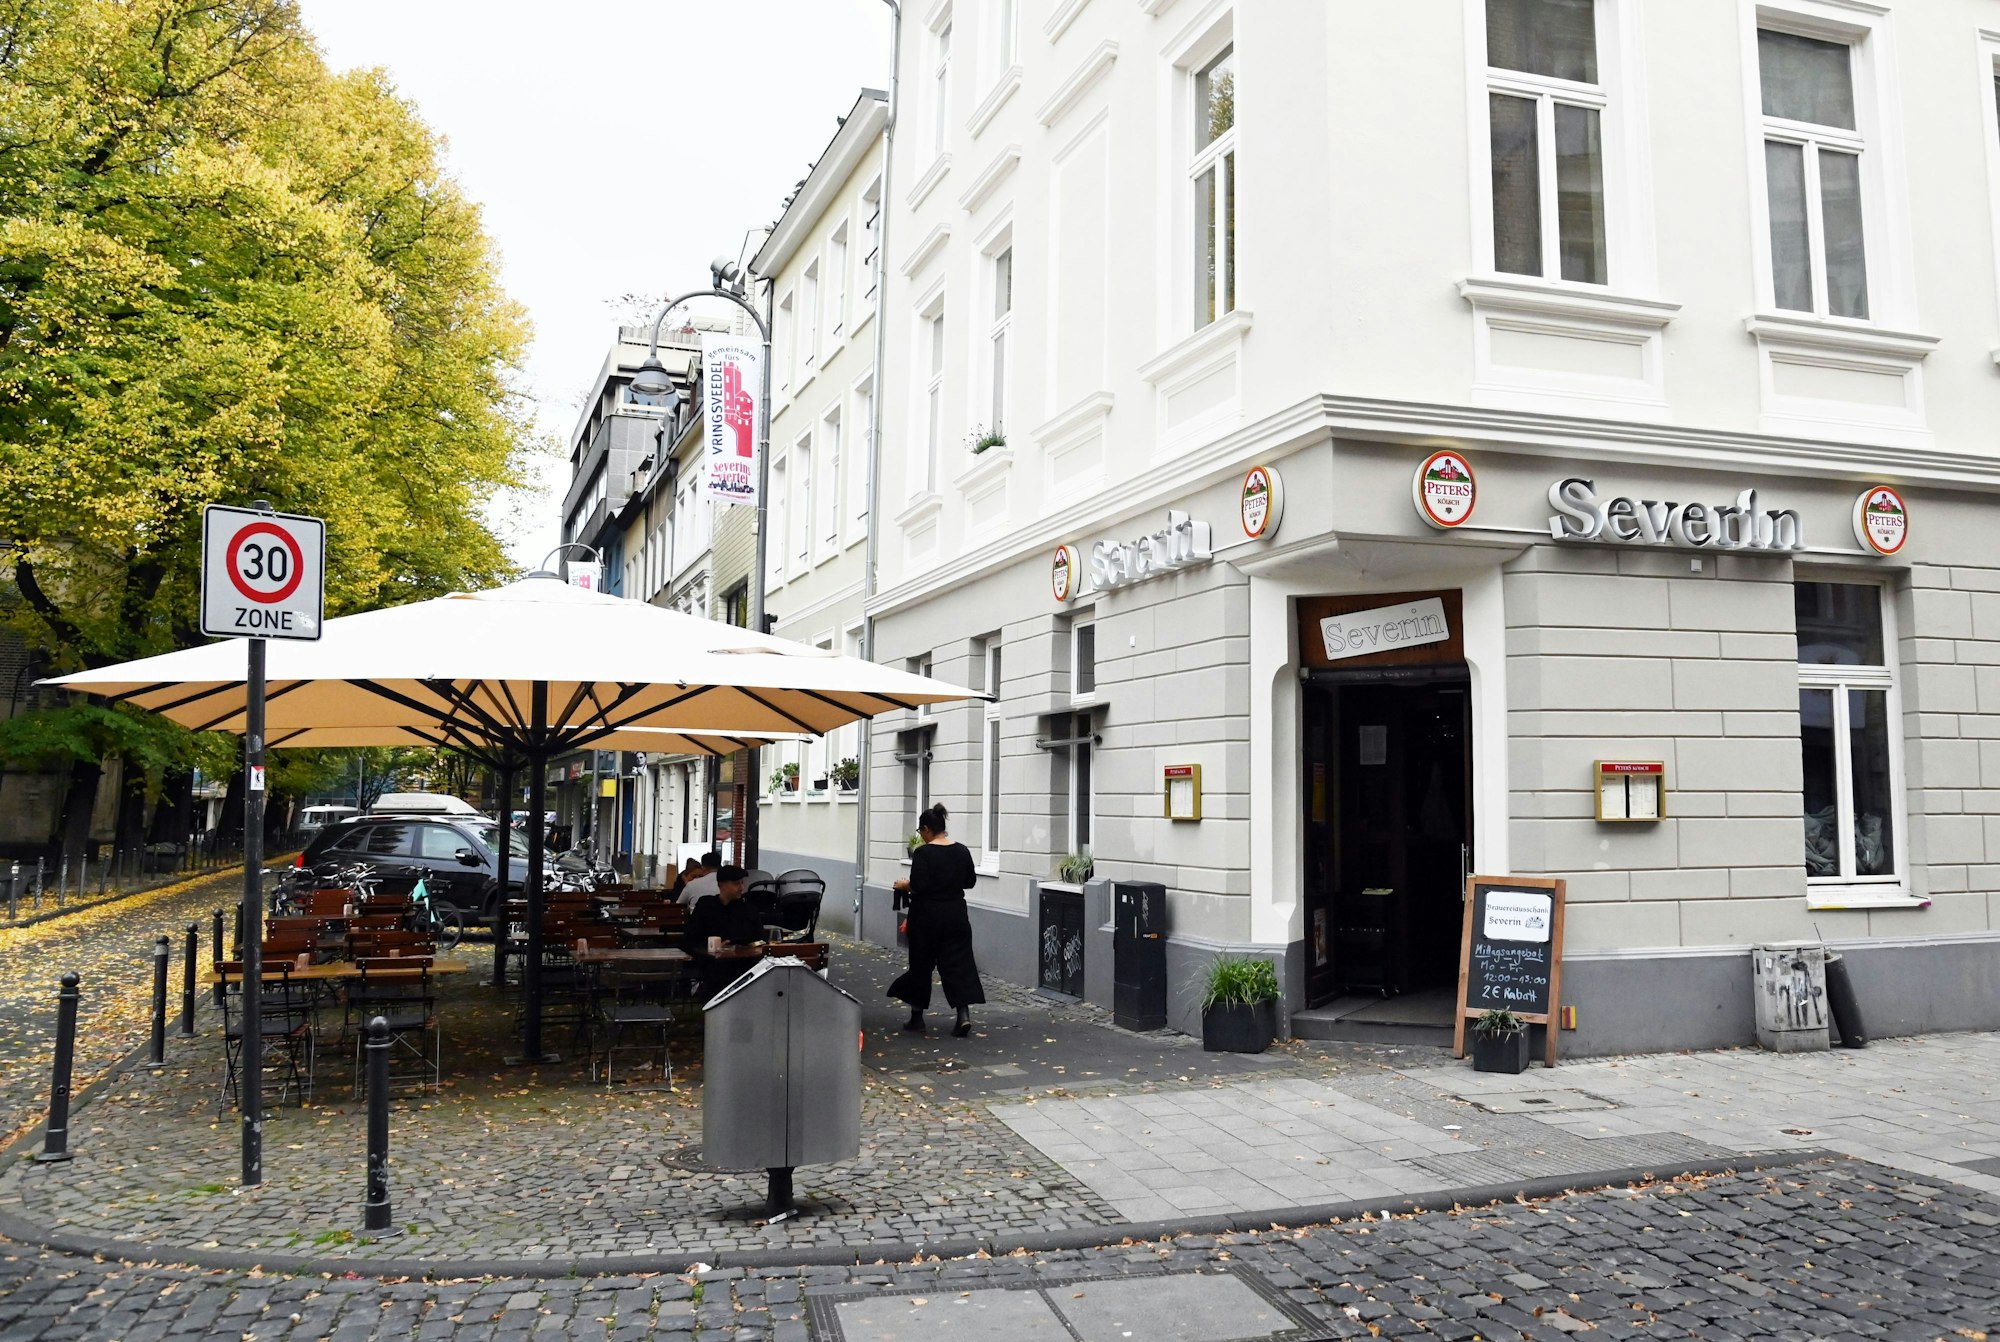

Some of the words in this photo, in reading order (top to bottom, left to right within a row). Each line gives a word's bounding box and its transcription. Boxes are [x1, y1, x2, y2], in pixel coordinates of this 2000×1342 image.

[707, 346, 756, 362] gemeinsam
[711, 361, 723, 455] VRINGSVEEDEL
[1427, 481, 1470, 497] PETERS
[1244, 494, 1267, 511] PETERS
[1547, 477, 1807, 553] Severin
[1868, 514, 1903, 527] PETERS
[243, 543, 287, 582] 30
[234, 607, 293, 630] ZONE
[1325, 608, 1445, 653] Severin
[1488, 916, 1522, 926] Severin
[1475, 944, 1544, 965] Mittagsangebot
[1480, 960, 1495, 971] Mo
[1504, 987, 1537, 1002] Rabatt
